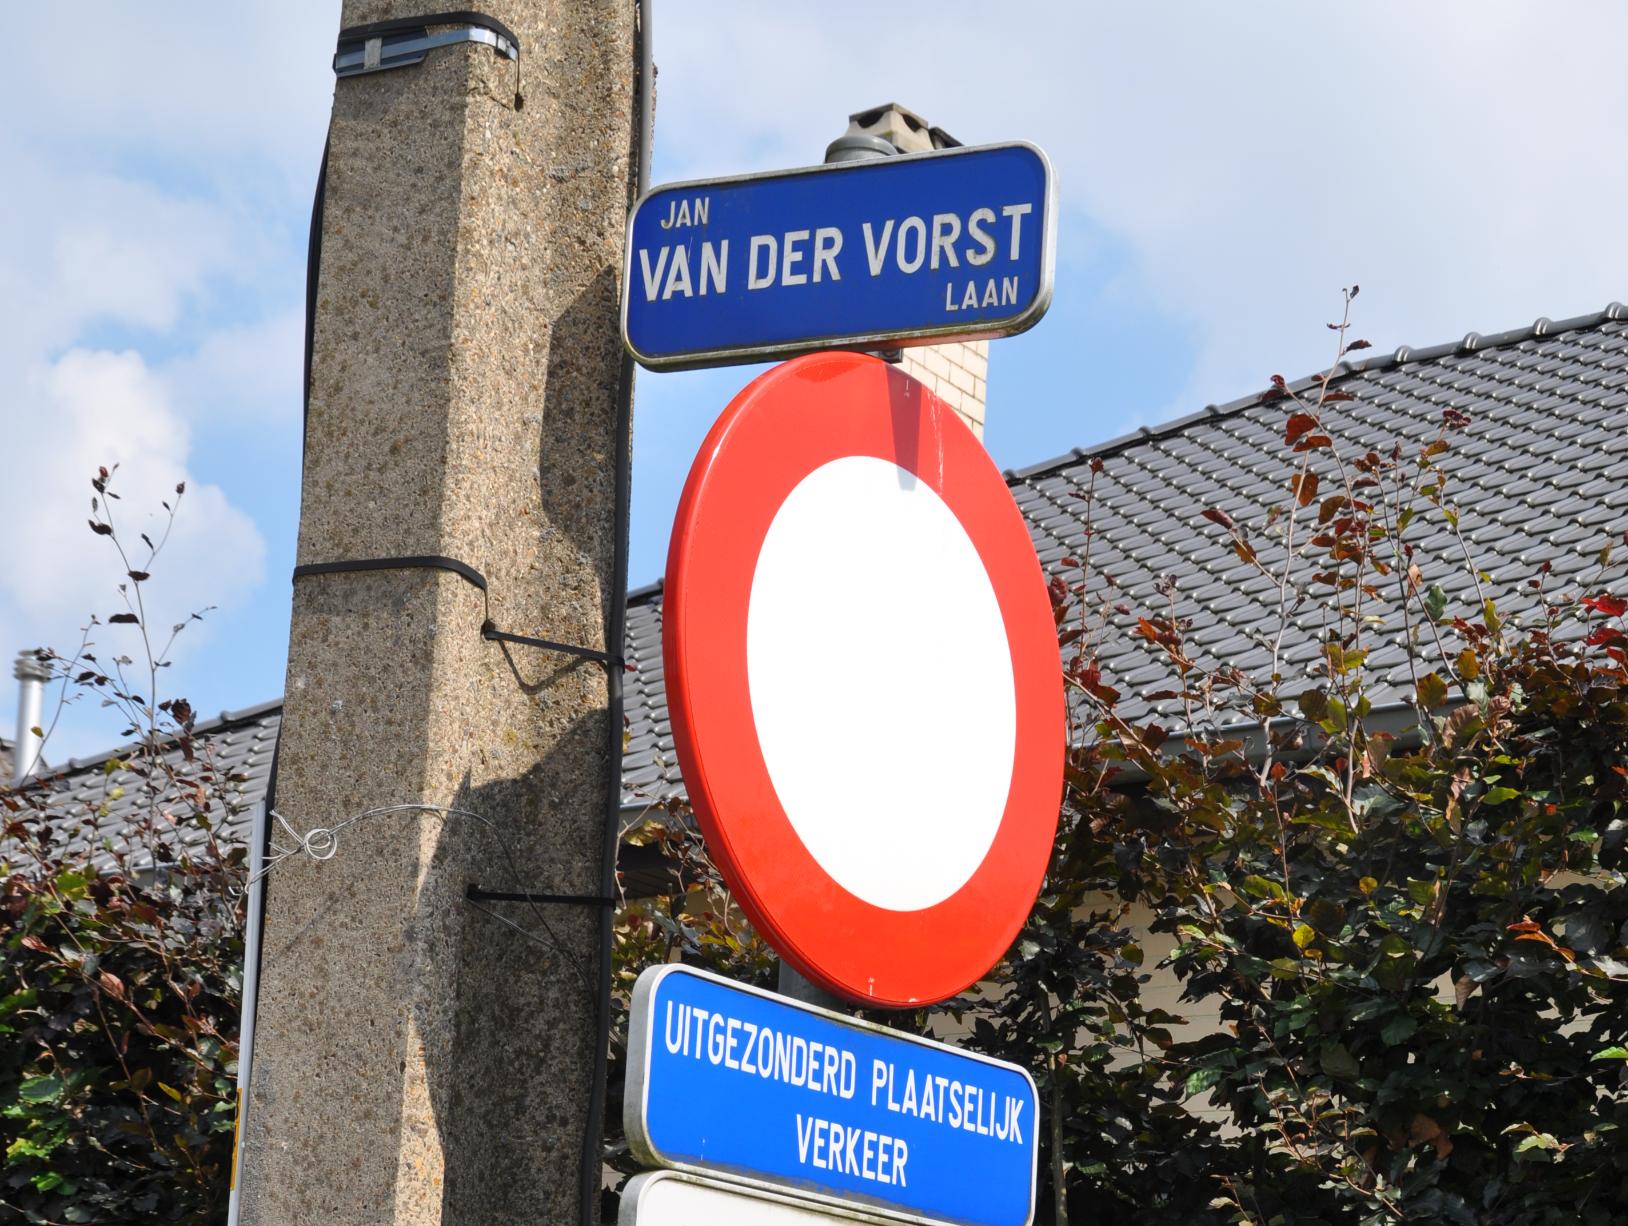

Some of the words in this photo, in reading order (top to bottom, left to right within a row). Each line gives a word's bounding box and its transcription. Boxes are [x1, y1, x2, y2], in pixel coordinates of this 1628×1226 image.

[660, 197, 710, 230] JAN
[639, 238, 729, 302] VAN
[747, 226, 844, 291] DER
[862, 203, 1033, 277] VORST
[945, 276, 1019, 311] LAAN
[665, 1000, 856, 1099] UITGEZONDERD
[871, 1059, 1025, 1144] PLAATSELIJK
[796, 1114, 909, 1187] VERKEER
